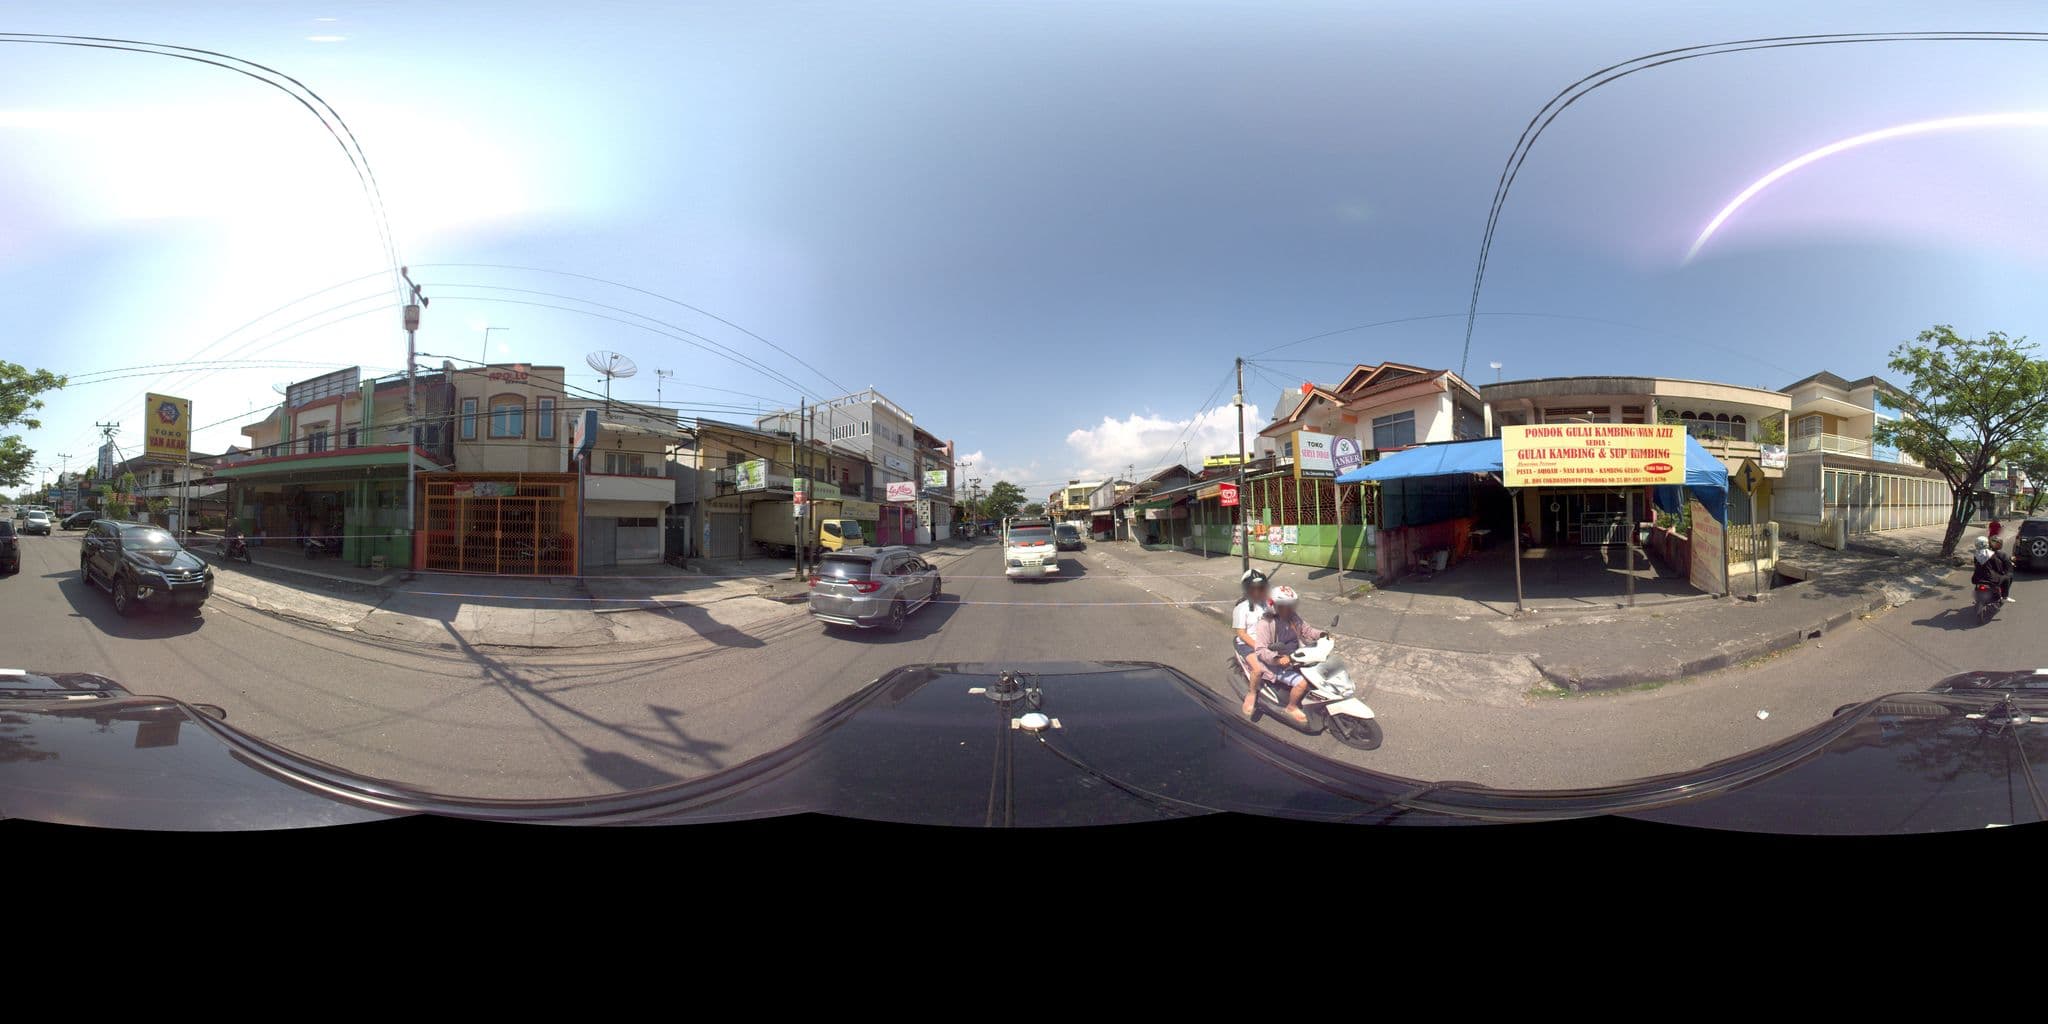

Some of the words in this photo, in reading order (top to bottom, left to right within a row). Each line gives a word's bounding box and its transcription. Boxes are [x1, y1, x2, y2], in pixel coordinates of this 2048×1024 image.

[155, 428, 182, 437] TOKO
[1525, 427, 1563, 438] PONDOK
[1566, 426, 1592, 437] GULAI
[1595, 426, 1635, 437] KAMBING
[1656, 428, 1673, 438] AZIZ
[1517, 448, 1546, 460] GULAI
[1549, 448, 1595, 459] KAMBING
[1598, 448, 1606, 458] &
[1609, 448, 1628, 459] SUP
[1335, 455, 1360, 466] ANKER
